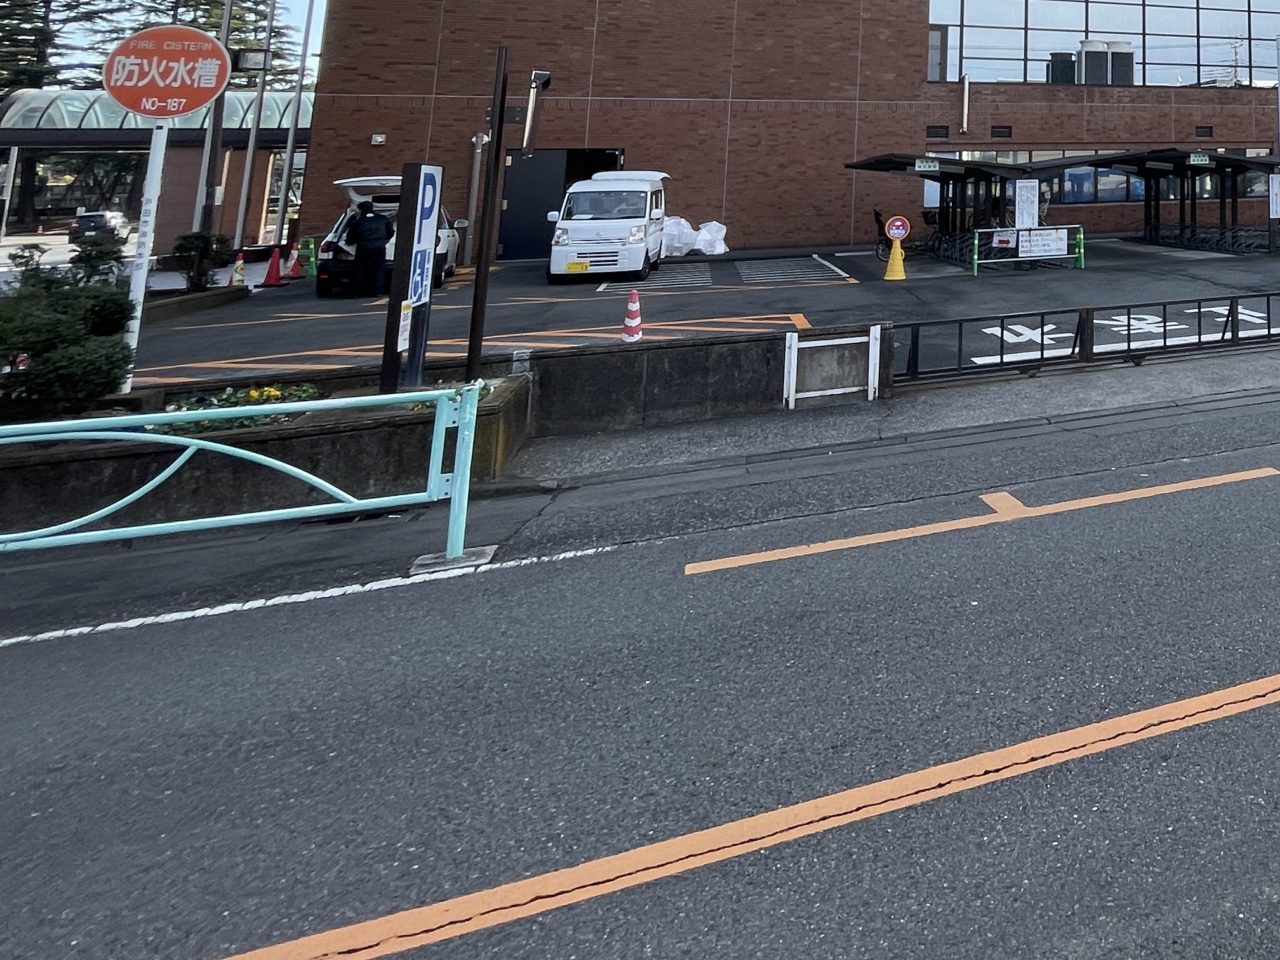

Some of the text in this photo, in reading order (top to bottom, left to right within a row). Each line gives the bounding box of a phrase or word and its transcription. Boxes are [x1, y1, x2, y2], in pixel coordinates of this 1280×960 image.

[129, 40, 212, 50] FIRE CISTERN
[110, 55, 221, 88] 防火水槽
[141, 97, 186, 111] NO-187
[417, 172, 437, 245] P
